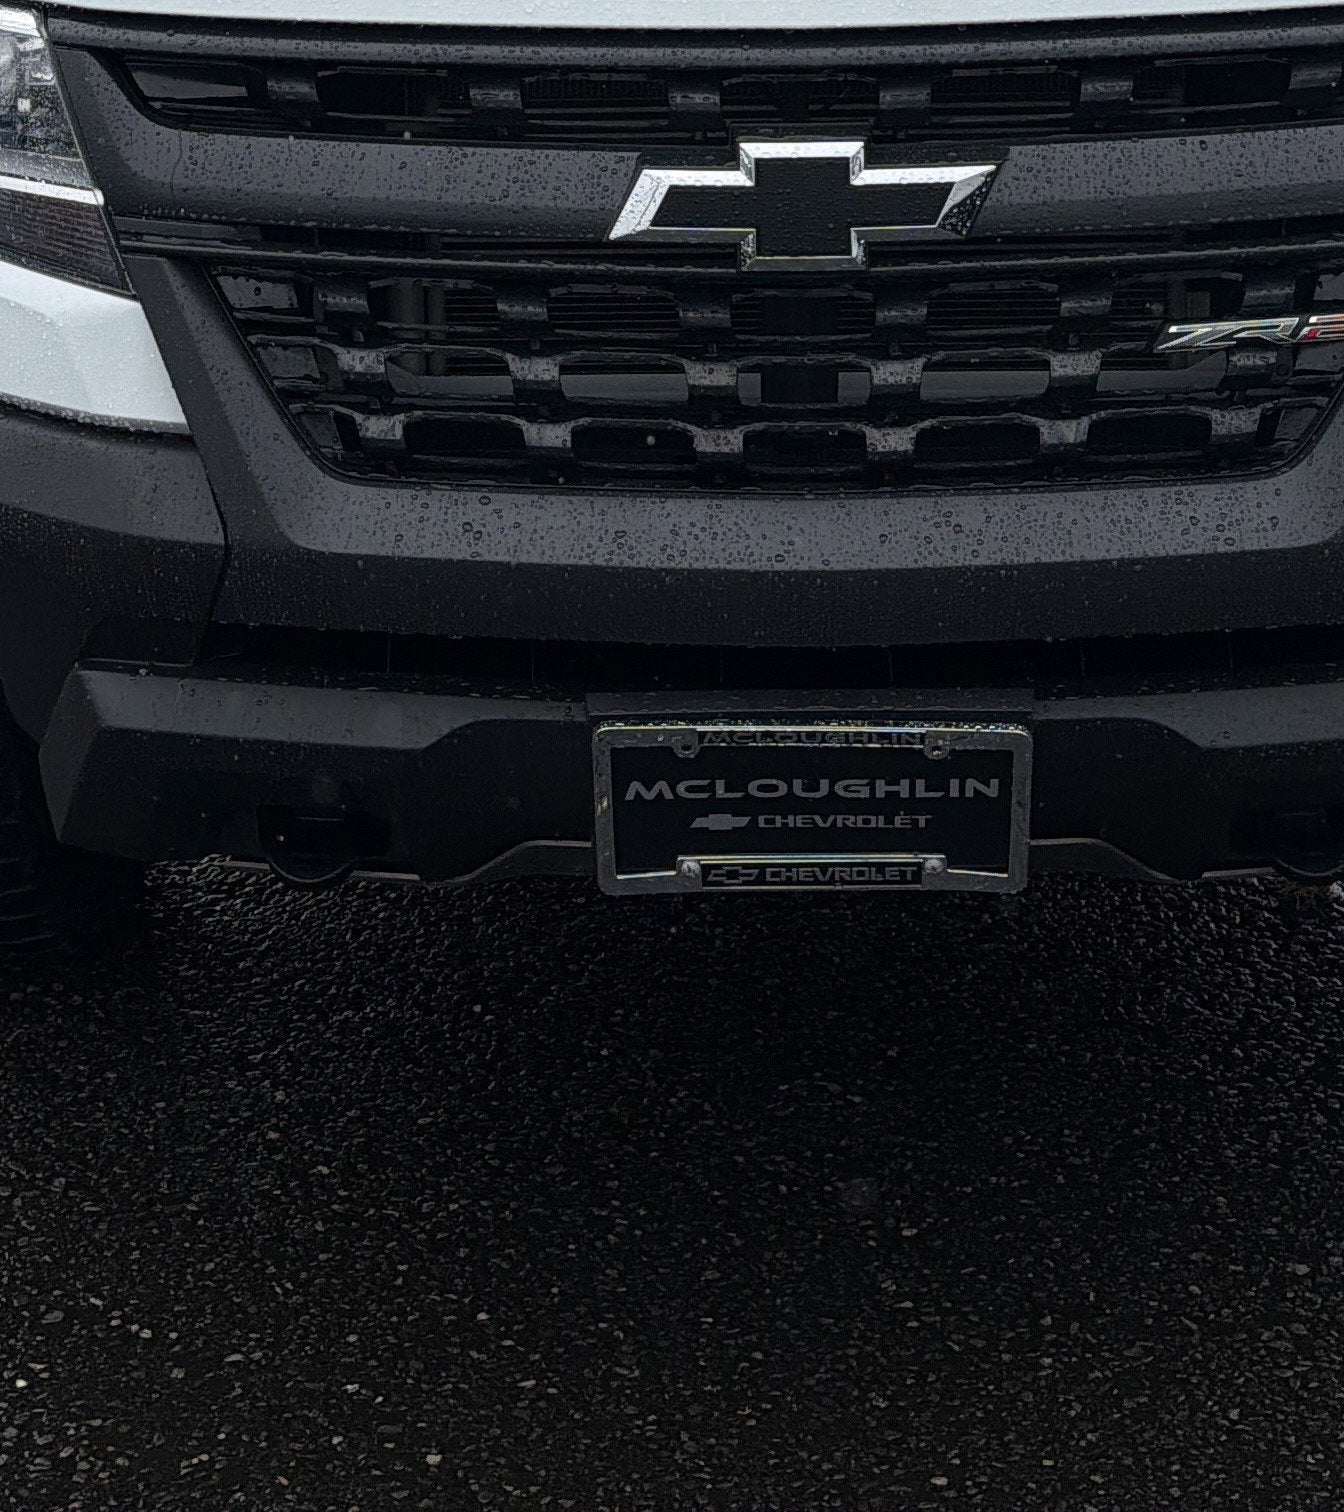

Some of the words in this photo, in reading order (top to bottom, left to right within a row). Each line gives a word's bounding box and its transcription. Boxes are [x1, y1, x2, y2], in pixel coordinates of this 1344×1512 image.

[624, 777, 1000, 801] MCLOUGHLIN
[757, 813, 932, 829] CHEVROLET
[764, 865, 918, 883] CHEVROLET
